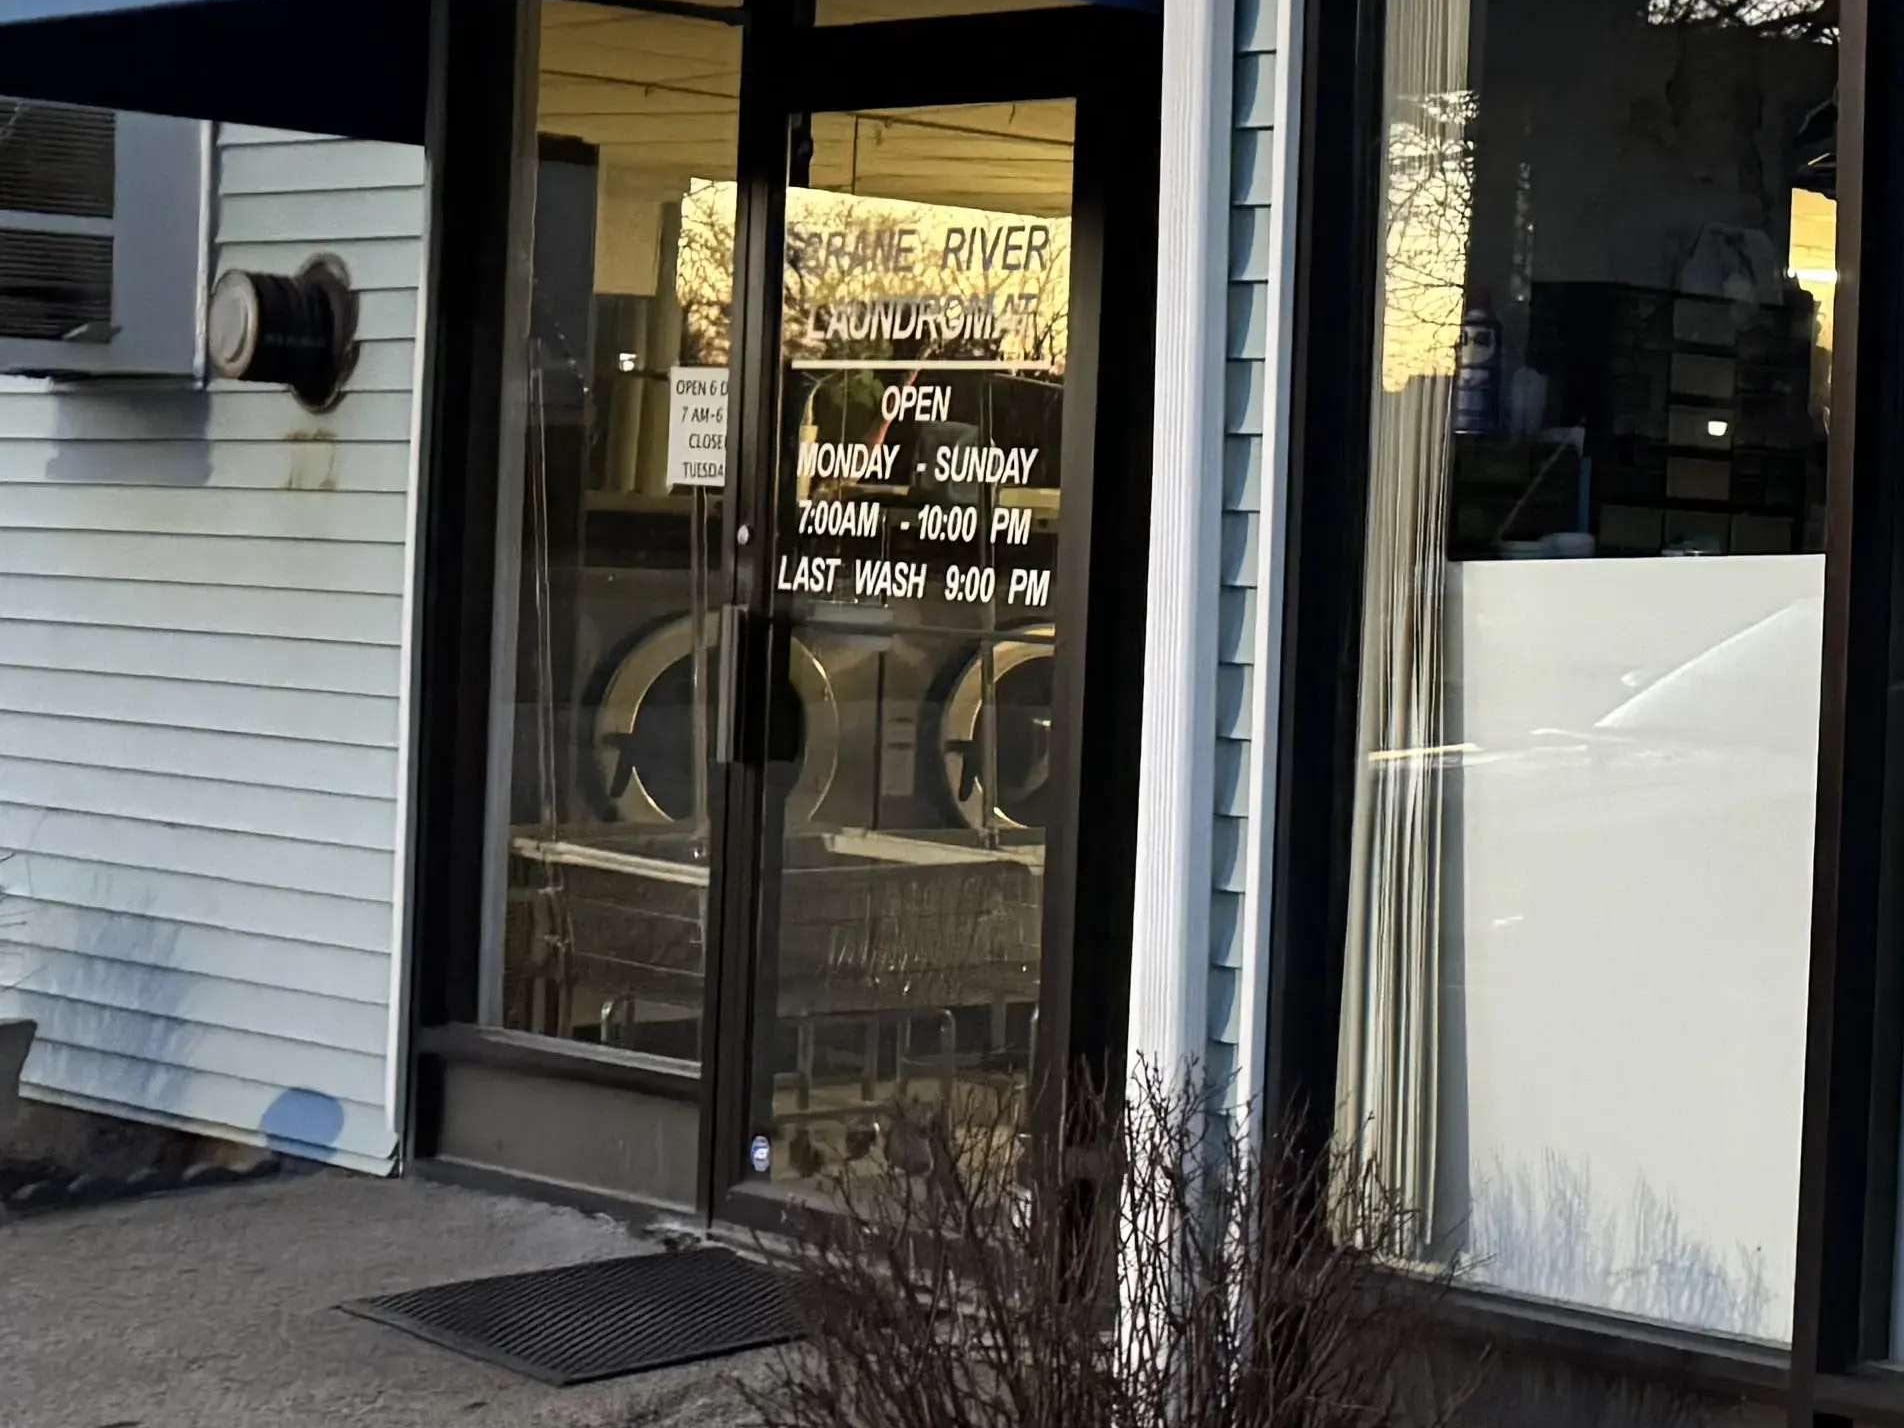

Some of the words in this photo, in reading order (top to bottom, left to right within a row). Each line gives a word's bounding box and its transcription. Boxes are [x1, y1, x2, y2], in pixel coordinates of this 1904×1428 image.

[941, 223, 1051, 272] RIVER
[806, 292, 1039, 341] LAUNDROMAT
[676, 379, 706, 397] OPEN
[881, 385, 952, 422] OPEN
[688, 433, 727, 451] CLOSE
[796, 442, 900, 481] MONDAY
[934, 445, 1039, 486] SUNDAY
[917, 503, 977, 543] 10:00
[990, 507, 1032, 546] PM
[777, 554, 841, 594] LAST
[854, 559, 928, 600] WASH
[944, 566, 995, 604] 9:00
[1007, 568, 1051, 607] PM
